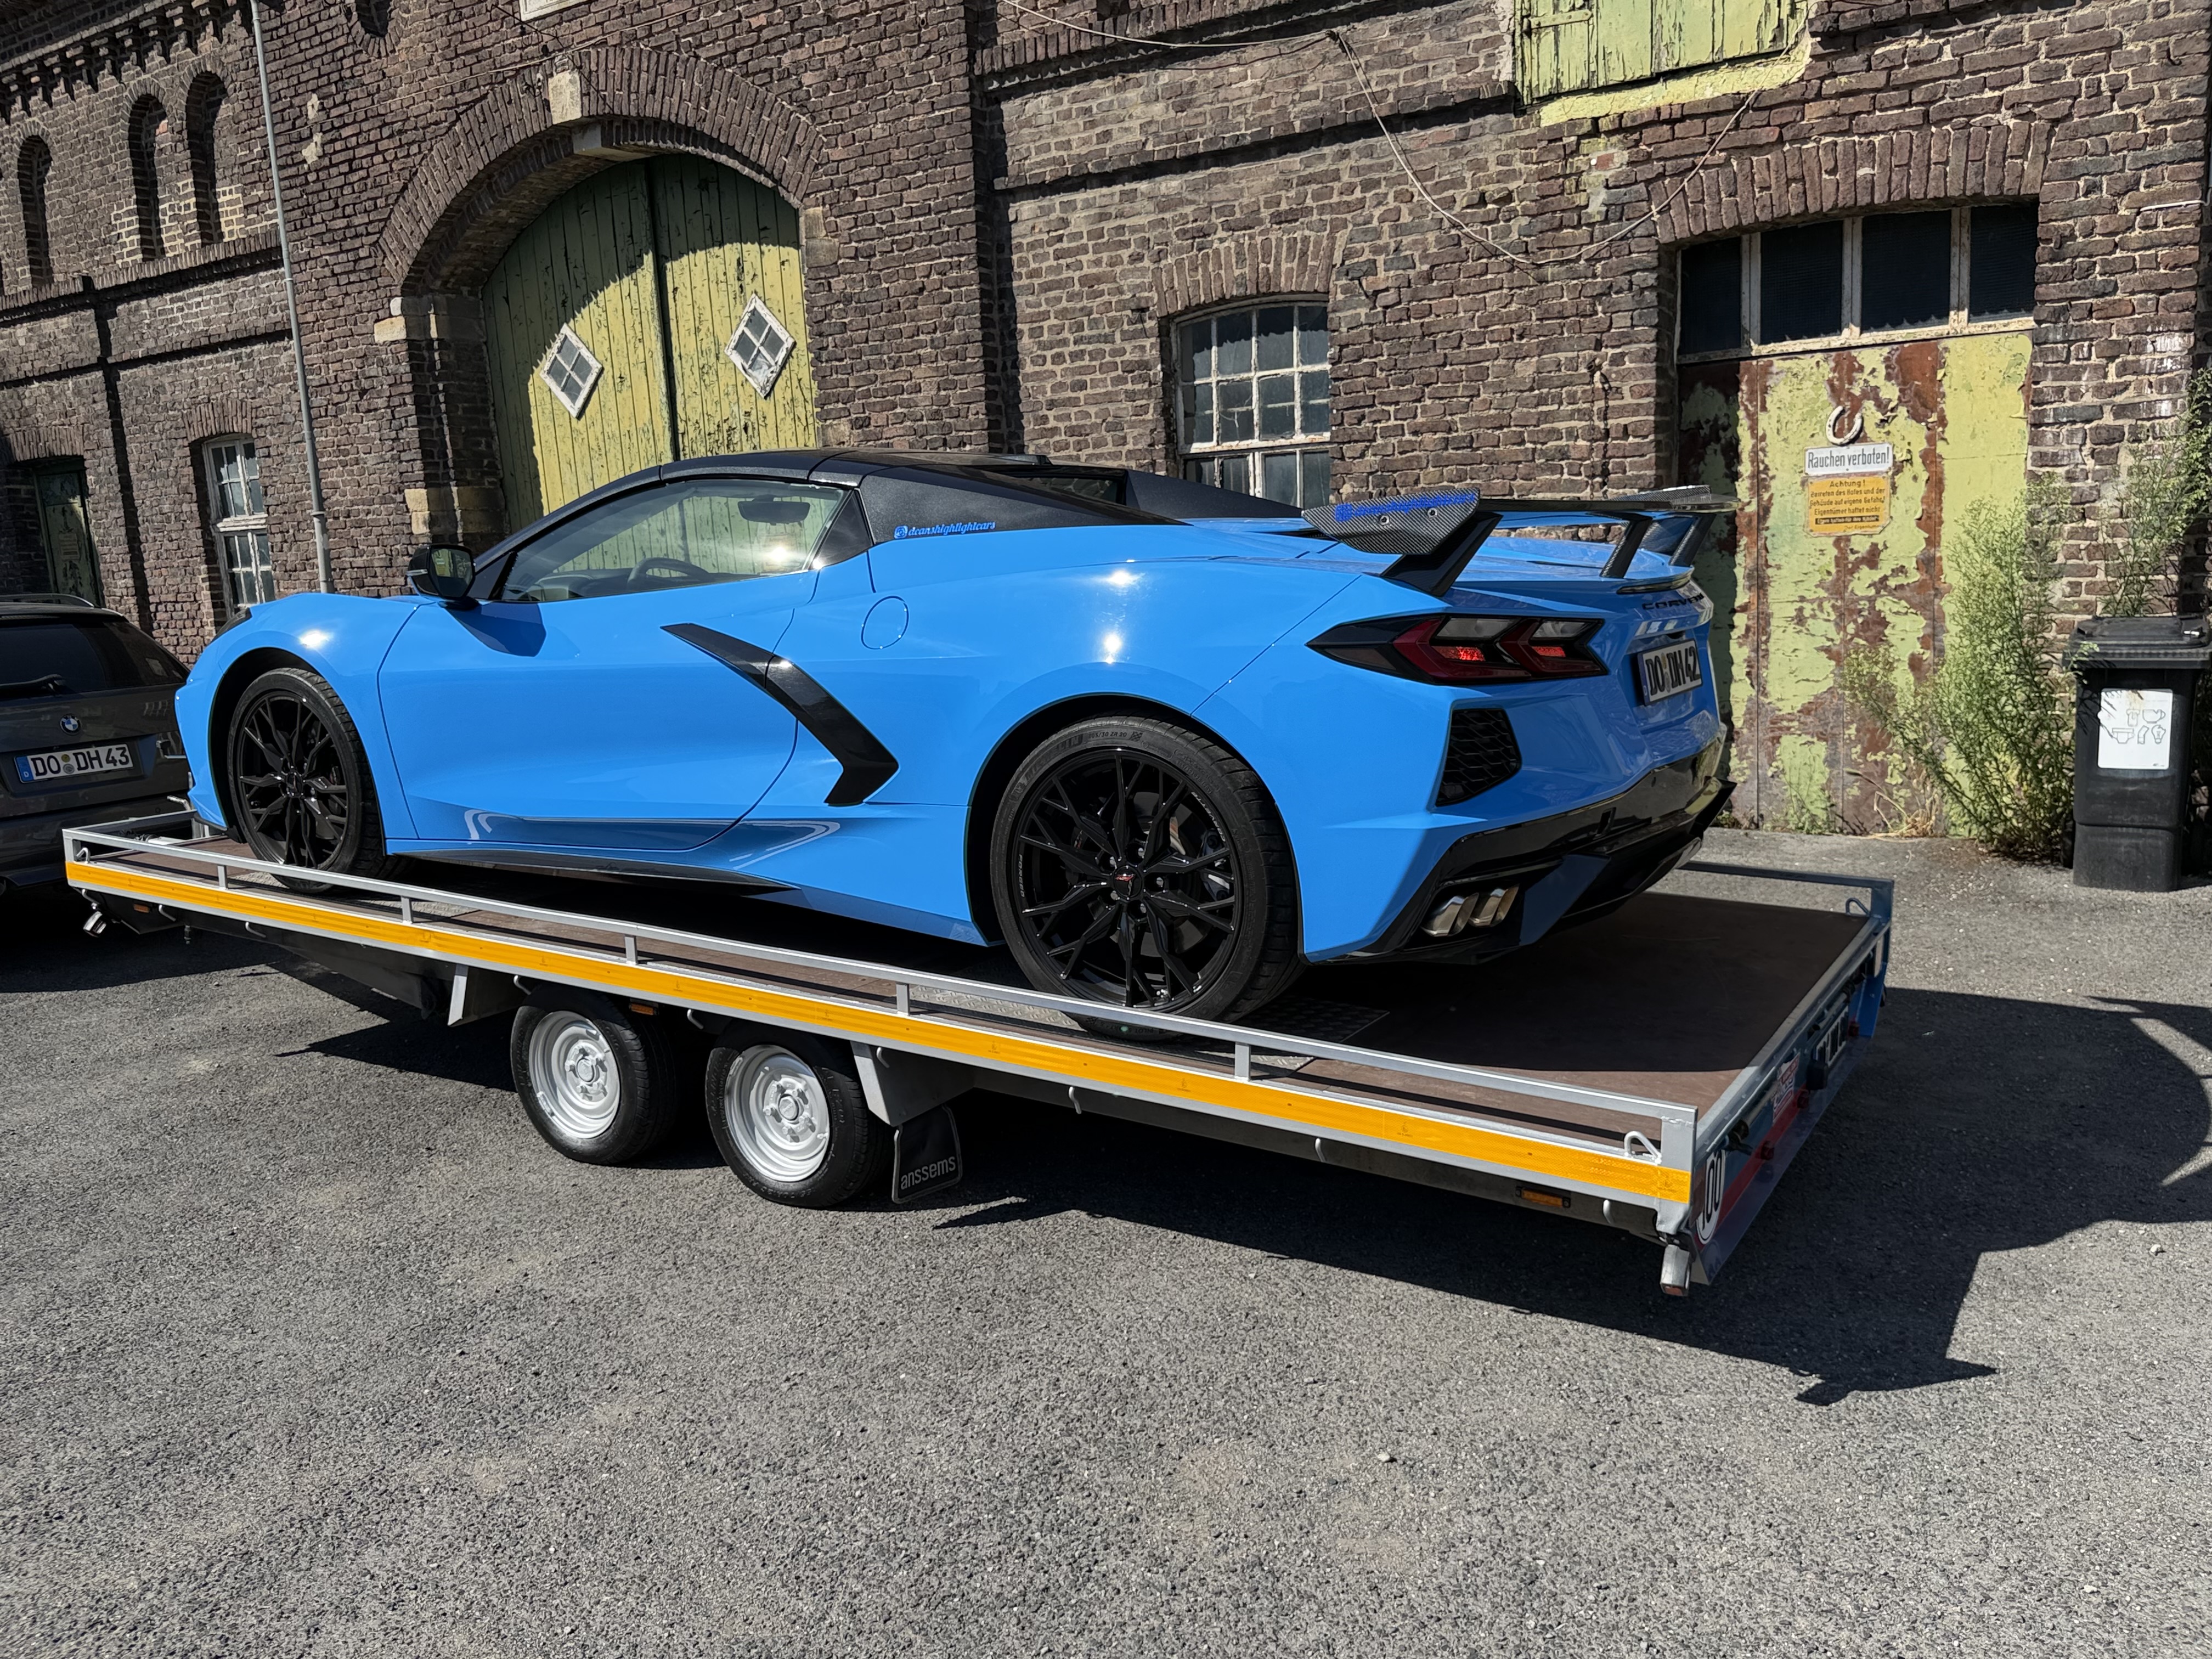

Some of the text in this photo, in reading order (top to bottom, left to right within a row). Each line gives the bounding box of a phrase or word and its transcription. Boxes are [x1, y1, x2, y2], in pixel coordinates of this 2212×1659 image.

[1808, 447, 1890, 469] Rauchen verboten!
[1814, 507, 1847, 516] Eigentümer
[1843, 498, 1862, 506] eigene
[1645, 646, 1701, 696] DO DH 42
[31, 747, 129, 776] DO DH 43
[900, 1156, 956, 1190] anssems
[1702, 1151, 1723, 1231] 00
